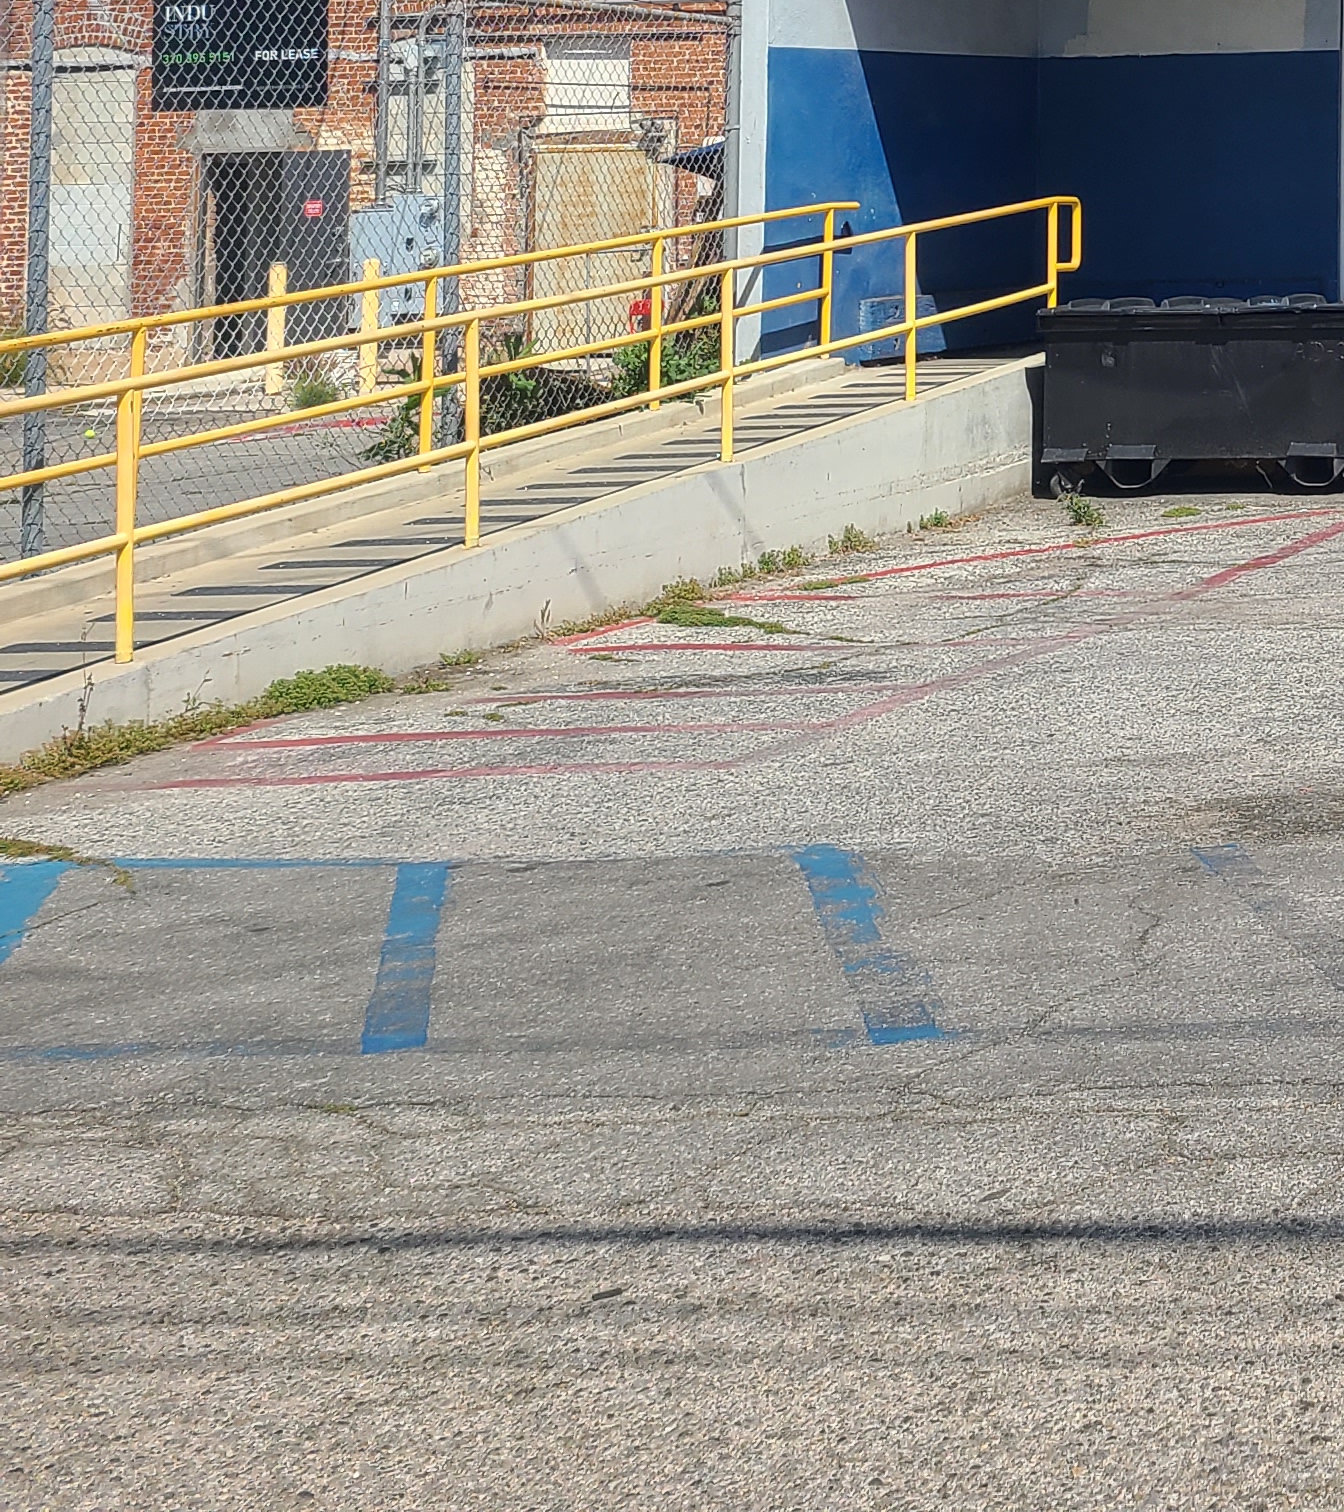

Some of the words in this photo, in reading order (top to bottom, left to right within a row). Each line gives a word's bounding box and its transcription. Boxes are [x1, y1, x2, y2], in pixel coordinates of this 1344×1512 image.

[164, 5, 215, 22] INDU
[255, 50, 278, 61] FOR
[281, 48, 320, 61] LEASE
